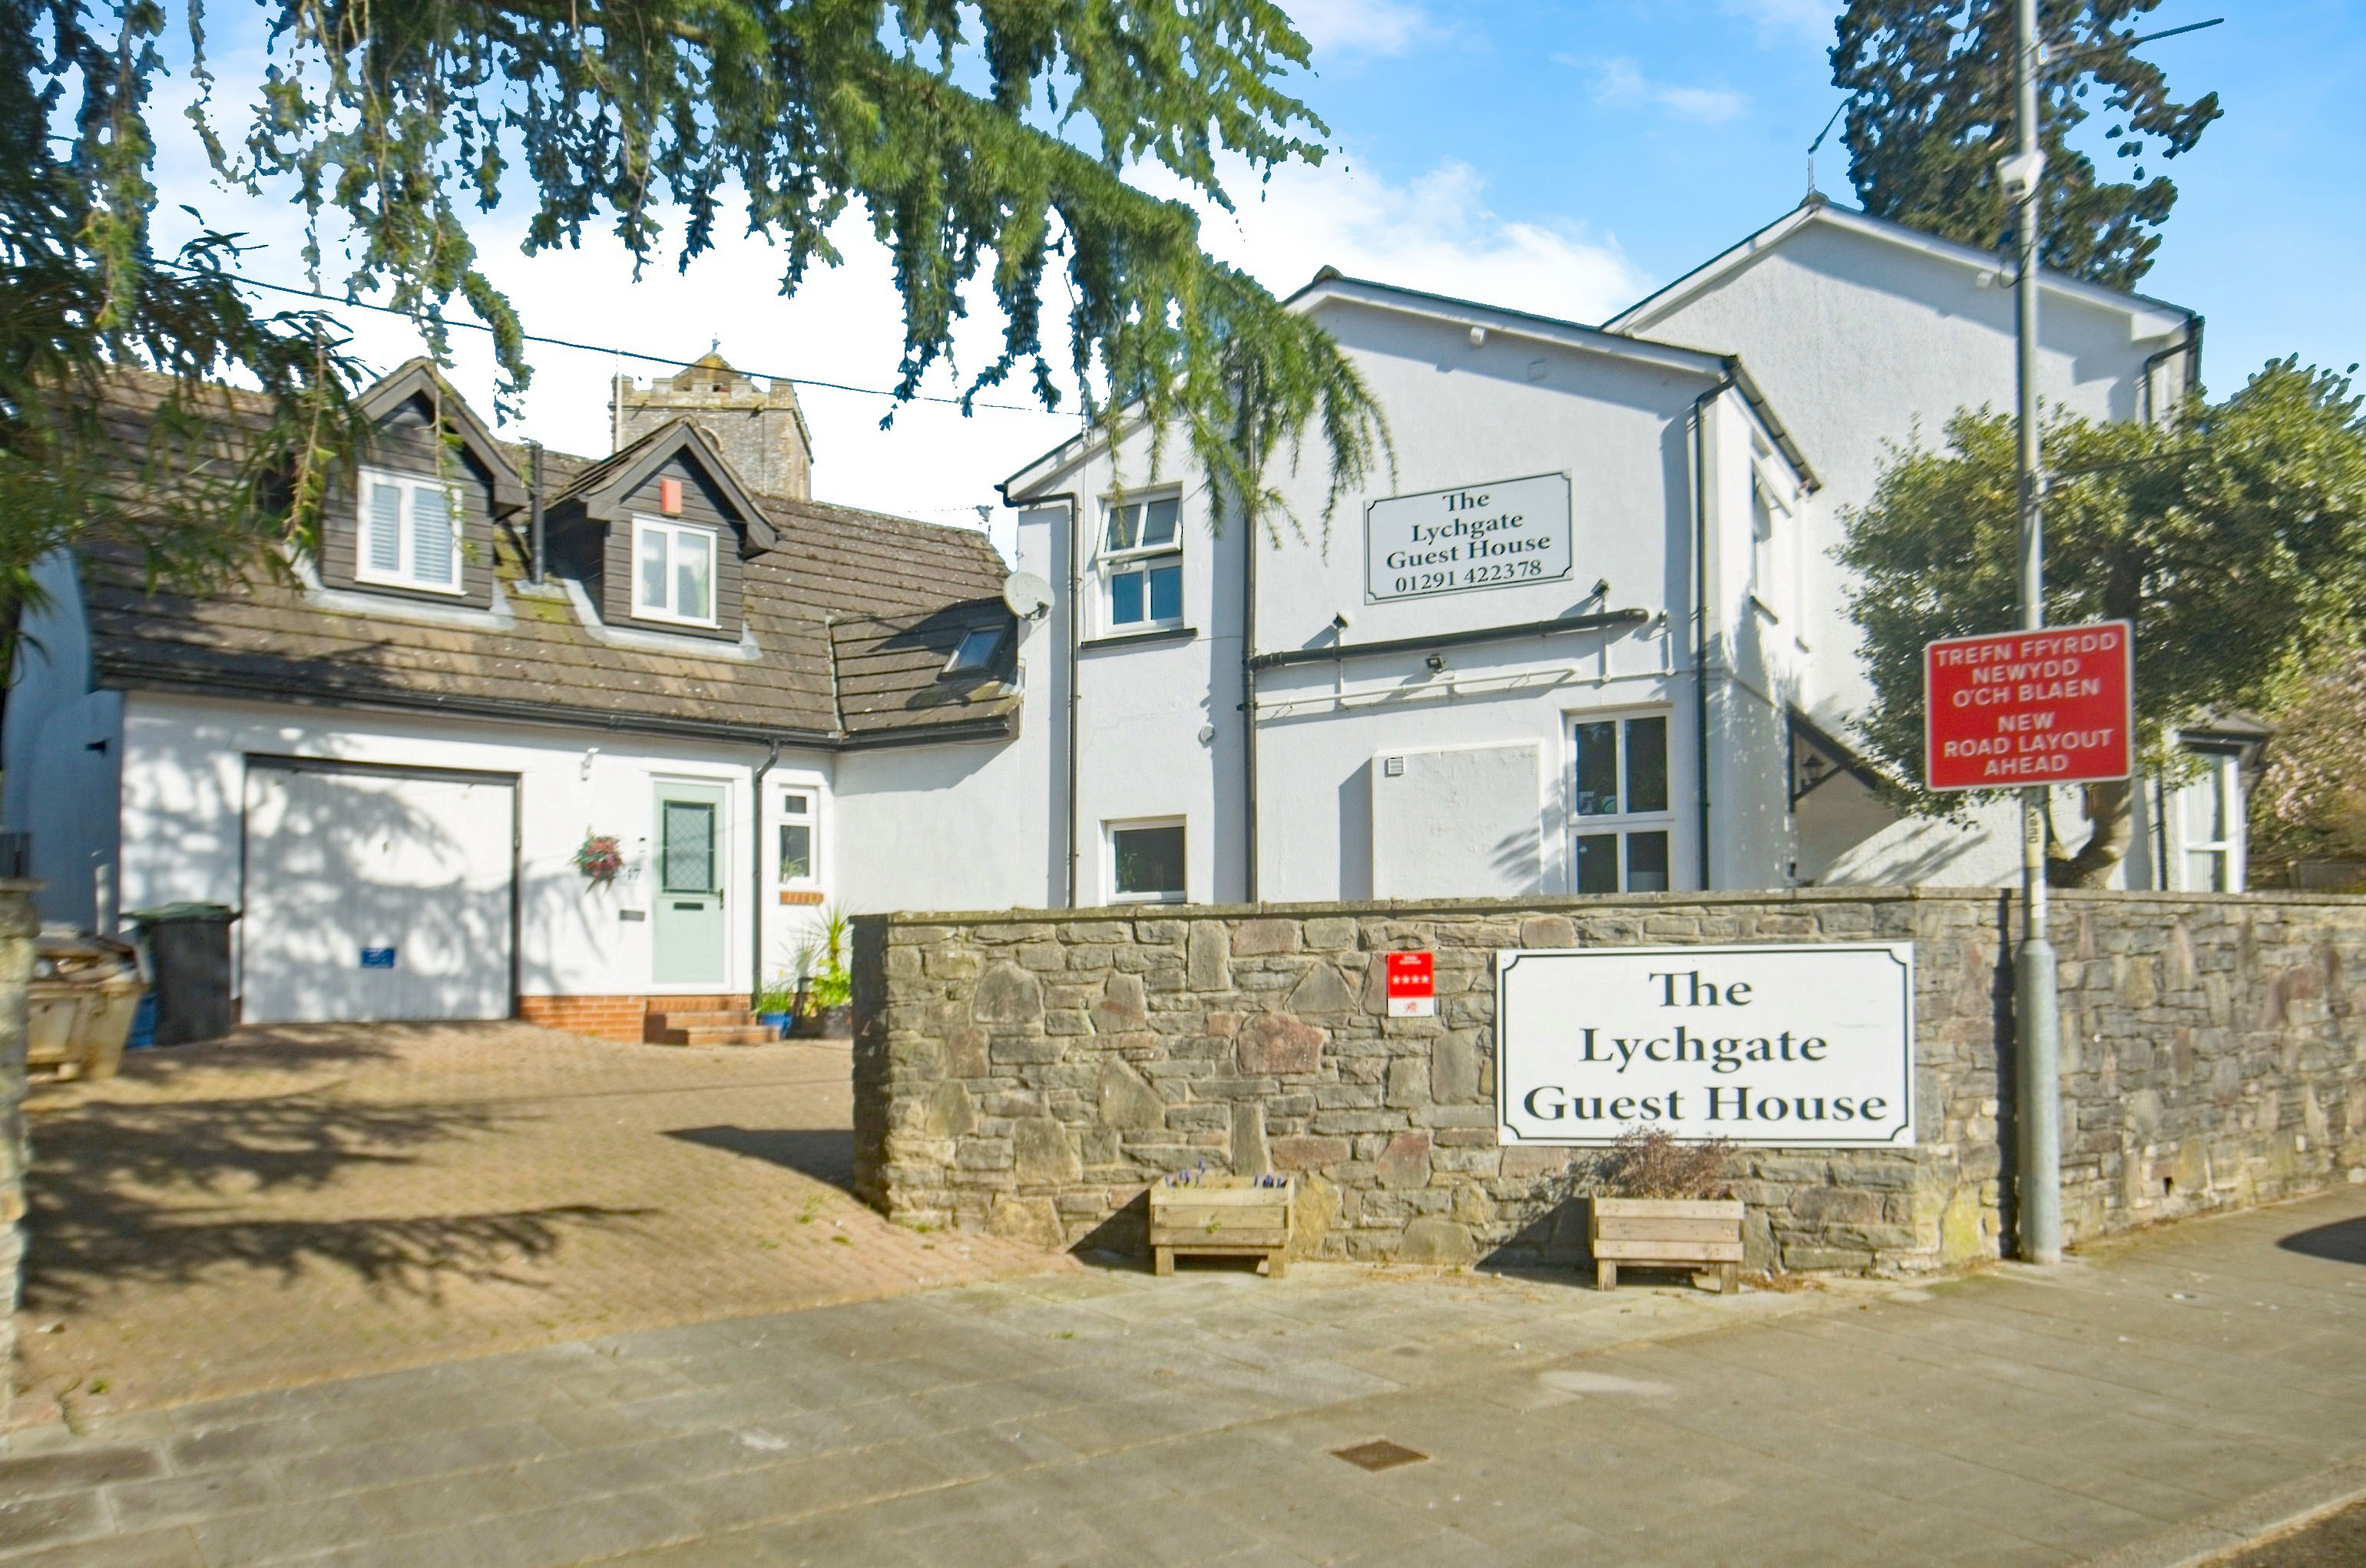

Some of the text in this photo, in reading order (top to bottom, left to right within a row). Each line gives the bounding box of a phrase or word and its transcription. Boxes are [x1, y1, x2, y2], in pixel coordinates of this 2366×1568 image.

[1443, 490, 1491, 512] The
[1411, 514, 1524, 545] Lychgate
[1387, 536, 1552, 570] Guest House
[1395, 559, 1542, 593] 01291 422378
[1935, 632, 2119, 667] TREFN FFYRDD
[1972, 658, 2081, 684] NEWYDD
[2017, 678, 2101, 703] BLAEN
[1997, 711, 2057, 733] NEW
[1944, 729, 2114, 759] ROAD LAYOUT
[1984, 754, 2070, 776] AHEAD
[1649, 970, 1753, 1007] The
[1579, 1025, 1828, 1074] Lychgate
[1524, 1085, 1888, 1121] Guest House
